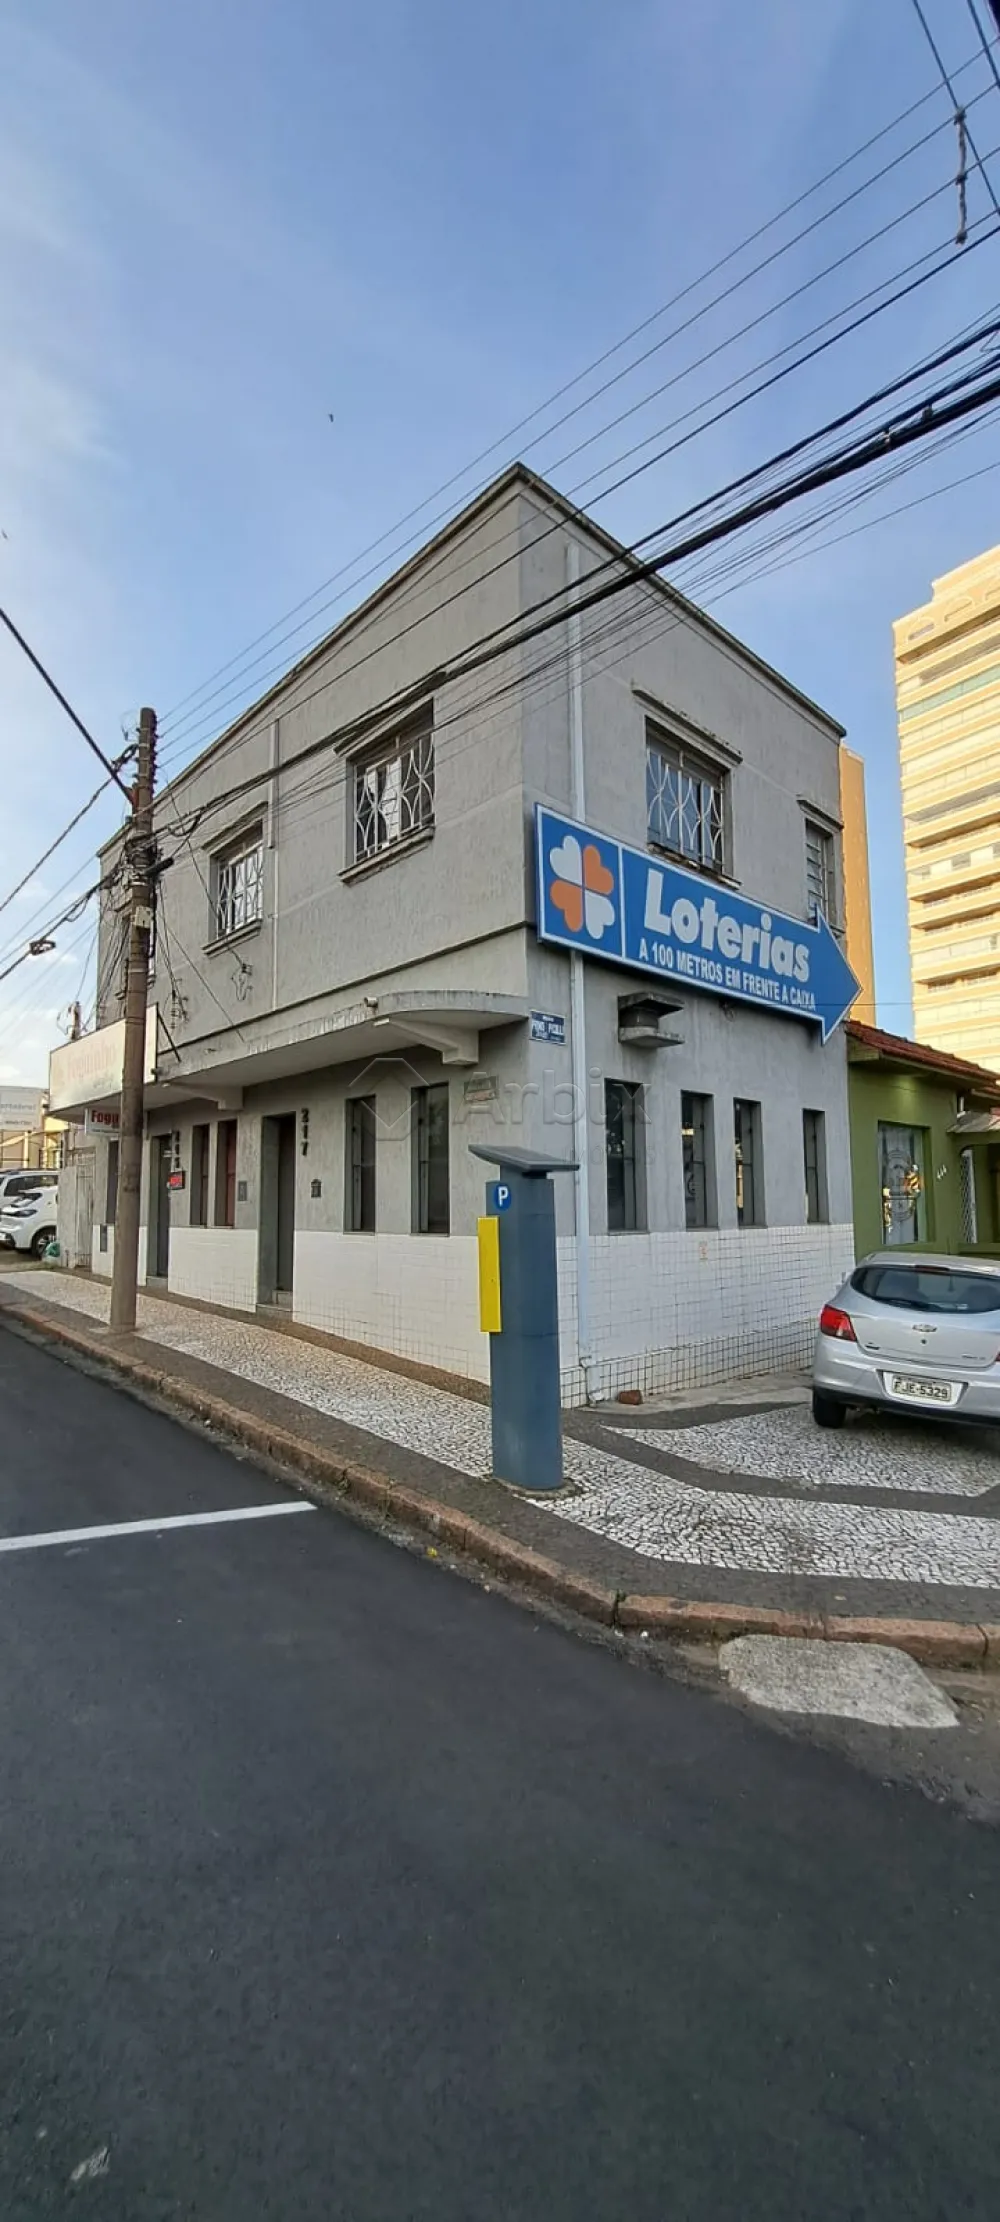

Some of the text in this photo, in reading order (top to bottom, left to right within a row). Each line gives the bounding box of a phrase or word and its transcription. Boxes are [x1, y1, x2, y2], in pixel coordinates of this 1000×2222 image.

[644, 868, 809, 982] Loterias
[639, 938, 816, 1011] A 100 METROS EM FRENTE A CAIXA
[498, 1186, 508, 1206] P
